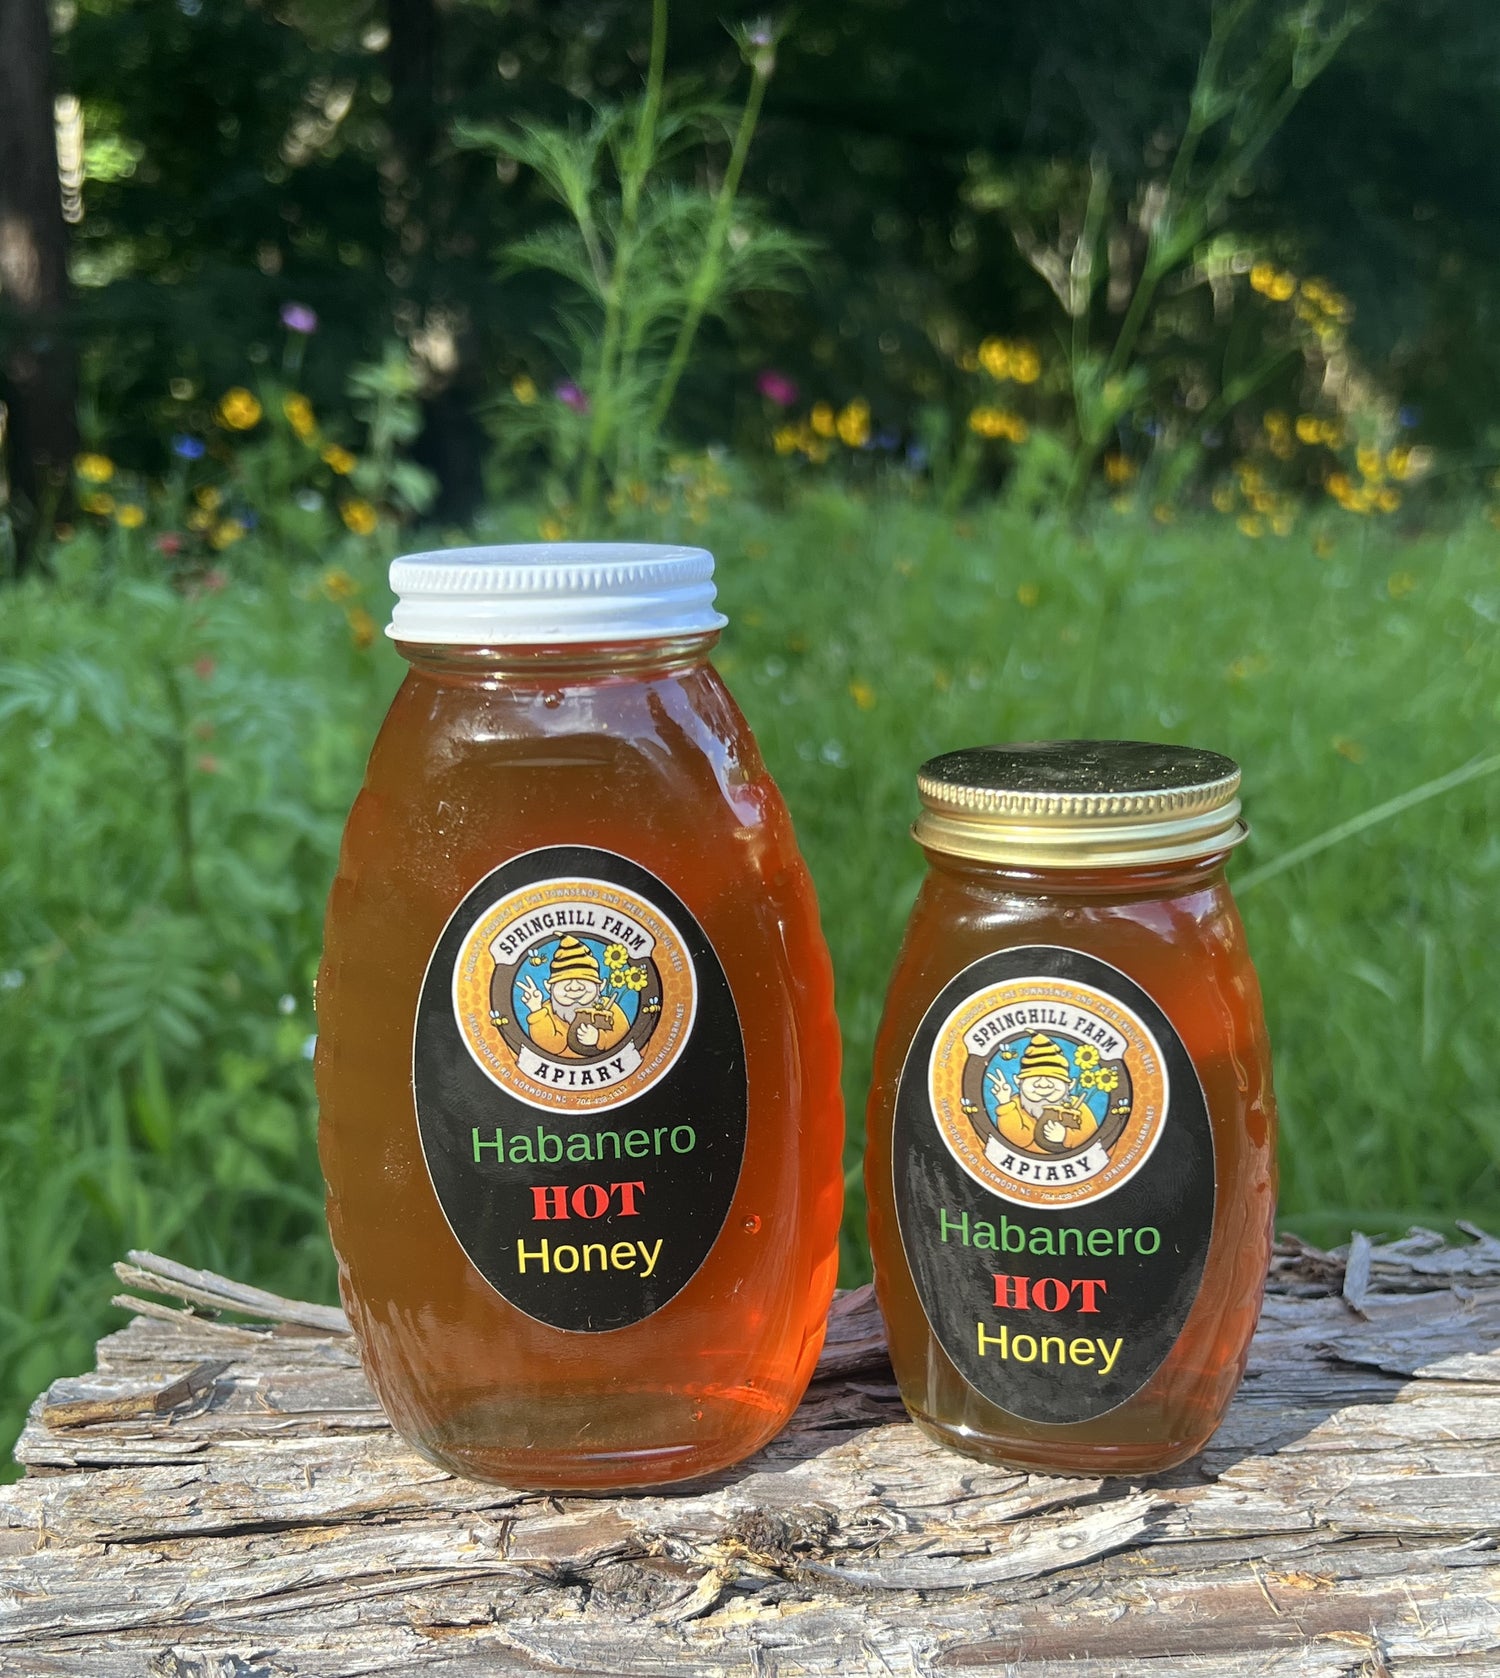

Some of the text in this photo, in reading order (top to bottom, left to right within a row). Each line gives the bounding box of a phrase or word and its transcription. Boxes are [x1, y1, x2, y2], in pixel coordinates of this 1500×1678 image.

[499, 910, 646, 956] SPRINGHILL FARM
[527, 893, 543, 906] THE
[546, 888, 599, 900] TOWNSENDS
[602, 892, 619, 904] AND
[622, 900, 645, 919] THEIR
[644, 915, 674, 950] SKILLFUL
[670, 951, 683, 973] BEES
[1019, 987, 1073, 1000] TOWNSENDS
[1076, 992, 1093, 1006] AND
[972, 1008, 1119, 1053] SPRINGHILL FARM
[476, 1037, 501, 1069] COOPER
[513, 1077, 553, 1101] NORWOOD
[555, 1094, 567, 1103] NC
[637, 1002, 686, 1082] SPRINGHILLFARM.NET
[534, 1057, 626, 1086] APIARY
[471, 1124, 697, 1164] Habanero
[948, 1123, 969, 1155] COOPER
[979, 1165, 1018, 1191] NORWOOD
[1019, 1187, 1031, 1196] NC
[1103, 1105, 1156, 1183] SPRINGHILLFARM.NET
[1000, 1153, 1092, 1181] APIARY
[529, 1181, 646, 1221] HOT
[939, 1207, 1162, 1257] Habanero
[516, 1238, 664, 1278] Honey
[992, 1274, 1108, 1313] HOT
[977, 1322, 1123, 1376] Honey
